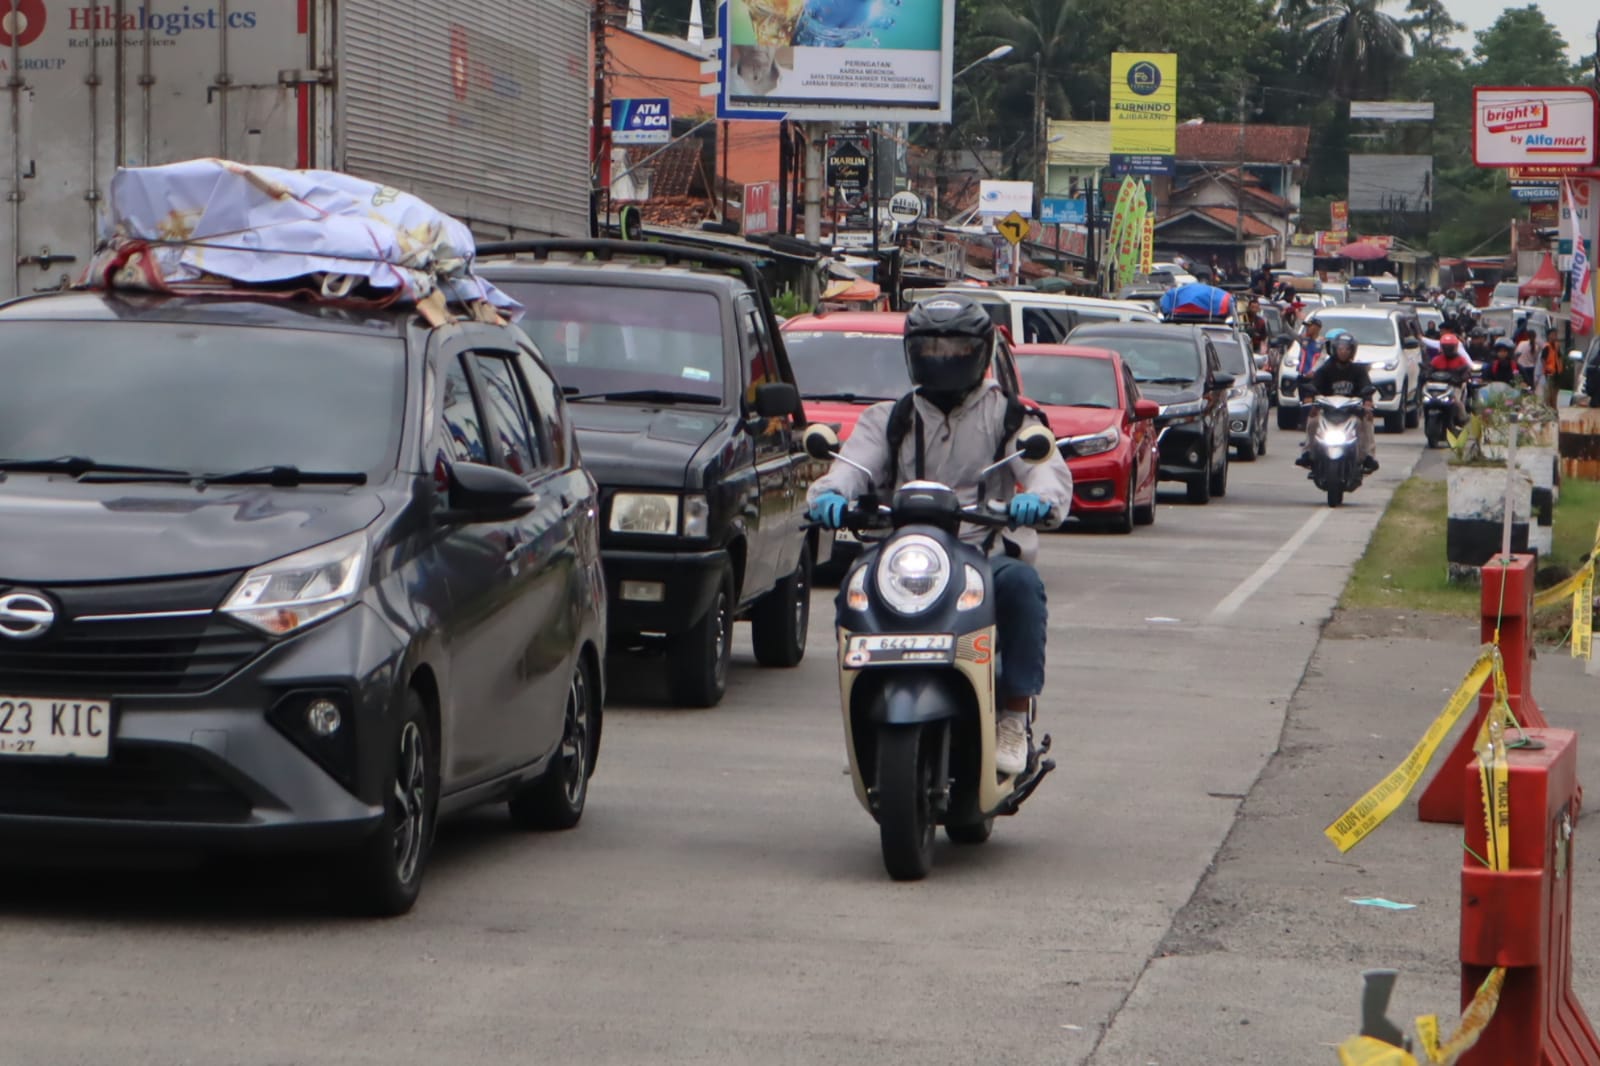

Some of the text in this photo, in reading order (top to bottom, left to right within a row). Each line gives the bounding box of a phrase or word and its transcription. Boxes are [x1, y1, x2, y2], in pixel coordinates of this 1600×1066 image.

[68, 5, 257, 36] Hibalogistcs
[636, 103, 661, 114] ATM
[1115, 102, 1171, 112] FURNINDO
[1487, 105, 1528, 121] bright
[644, 115, 667, 126] BCA
[1510, 134, 1586, 145] by Alfamart
[858, 639, 867, 649] R
[0, 701, 103, 737] 23 KIC
